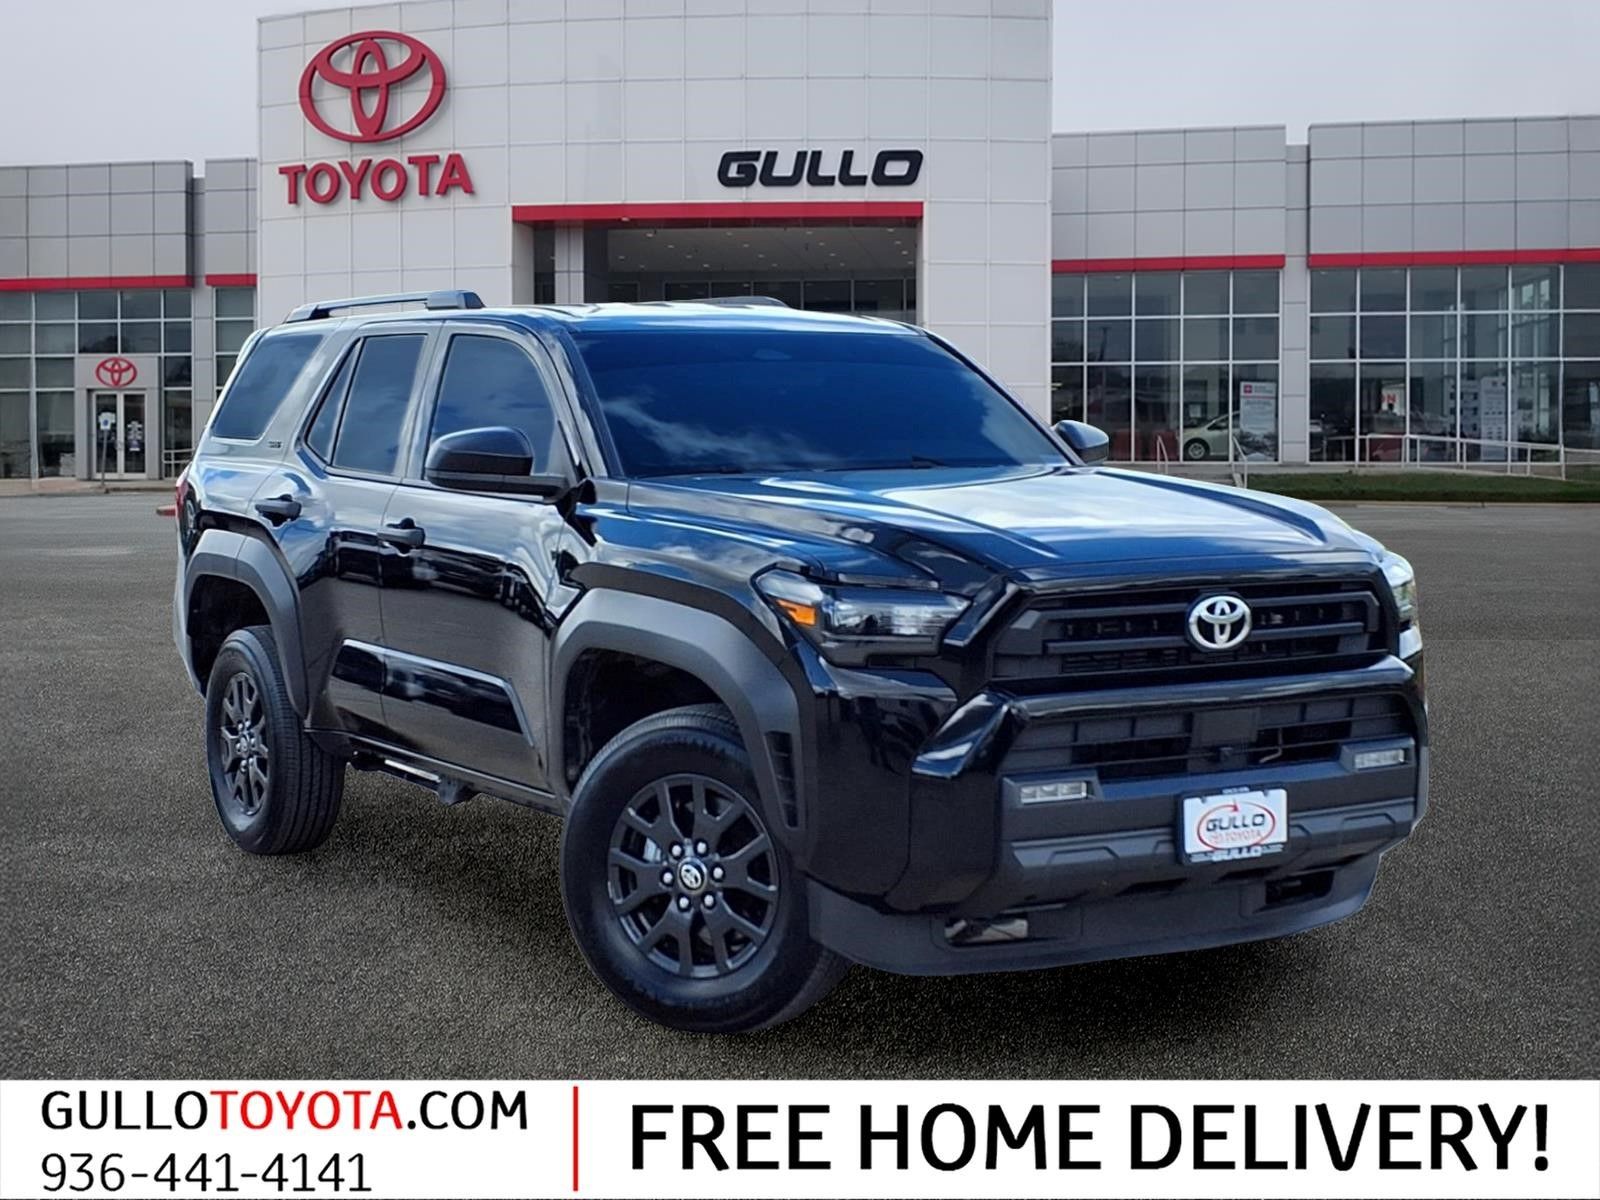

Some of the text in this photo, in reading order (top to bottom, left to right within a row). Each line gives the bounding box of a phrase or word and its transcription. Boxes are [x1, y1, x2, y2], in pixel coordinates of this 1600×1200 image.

[279, 153, 474, 204] TOYOTA
[717, 149, 924, 188] GULLO
[1206, 813, 1266, 832] GULLO
